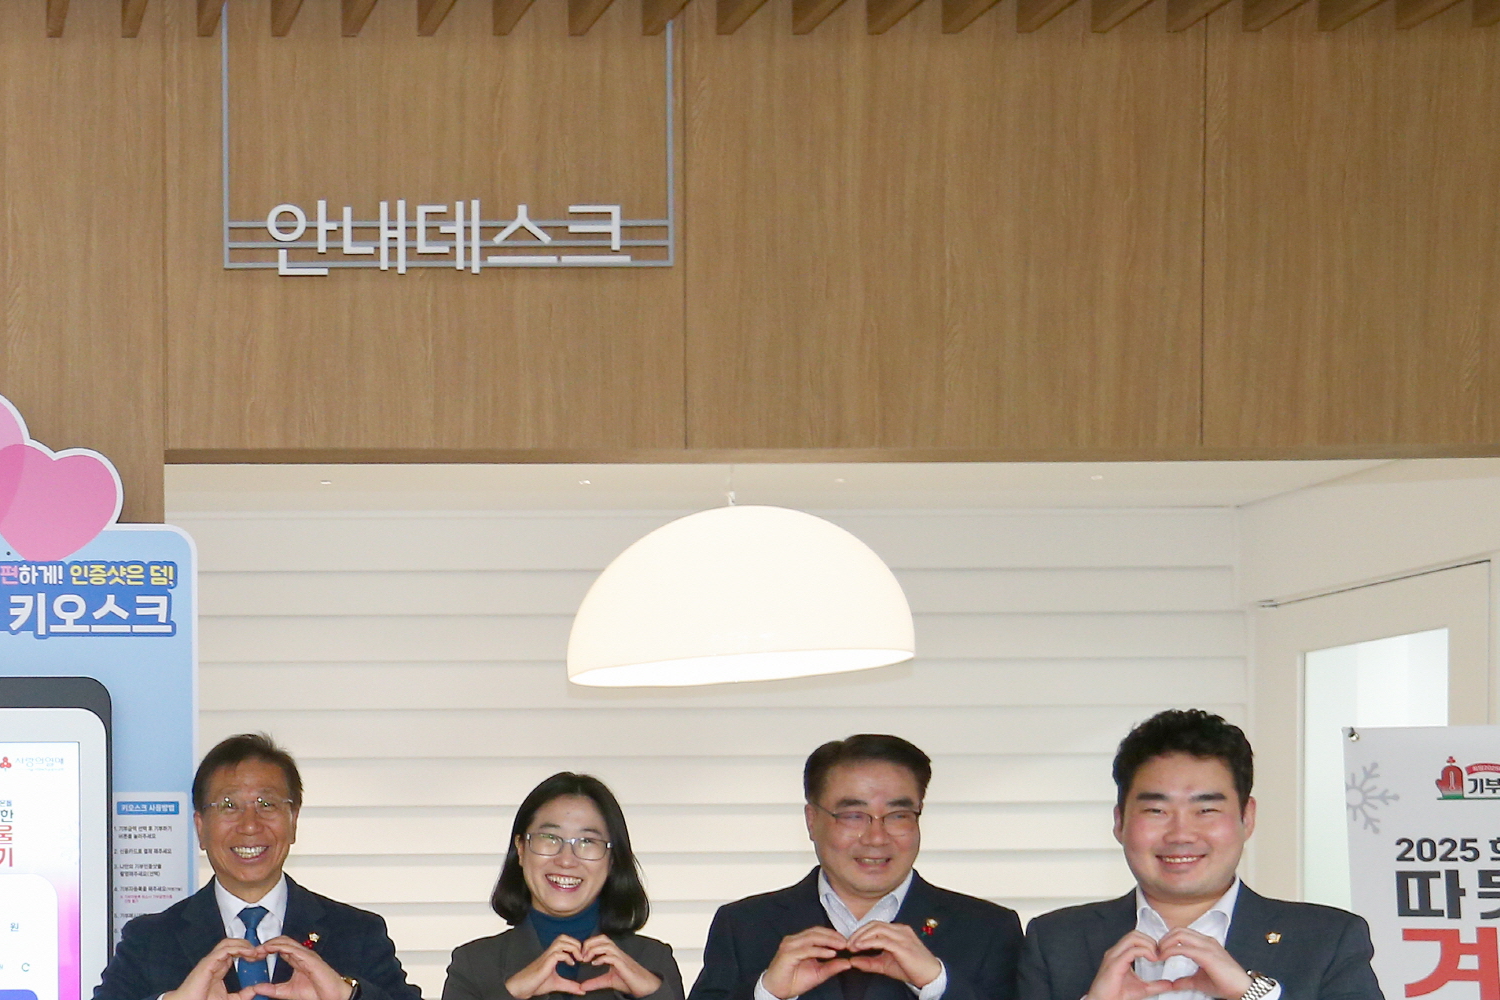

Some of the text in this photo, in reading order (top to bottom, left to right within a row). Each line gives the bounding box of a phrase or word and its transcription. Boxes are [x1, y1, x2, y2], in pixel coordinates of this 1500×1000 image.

[266, 199, 631, 275] 안내데스크
[70, 564, 145, 585] 인증샷은
[150, 564, 175, 585] 덤!
[10, 593, 173, 636] 키오스크
[121, 804, 148, 812] 키오스크
[1395, 837, 1480, 862] 2025
[10, 922, 20, 932] 원
